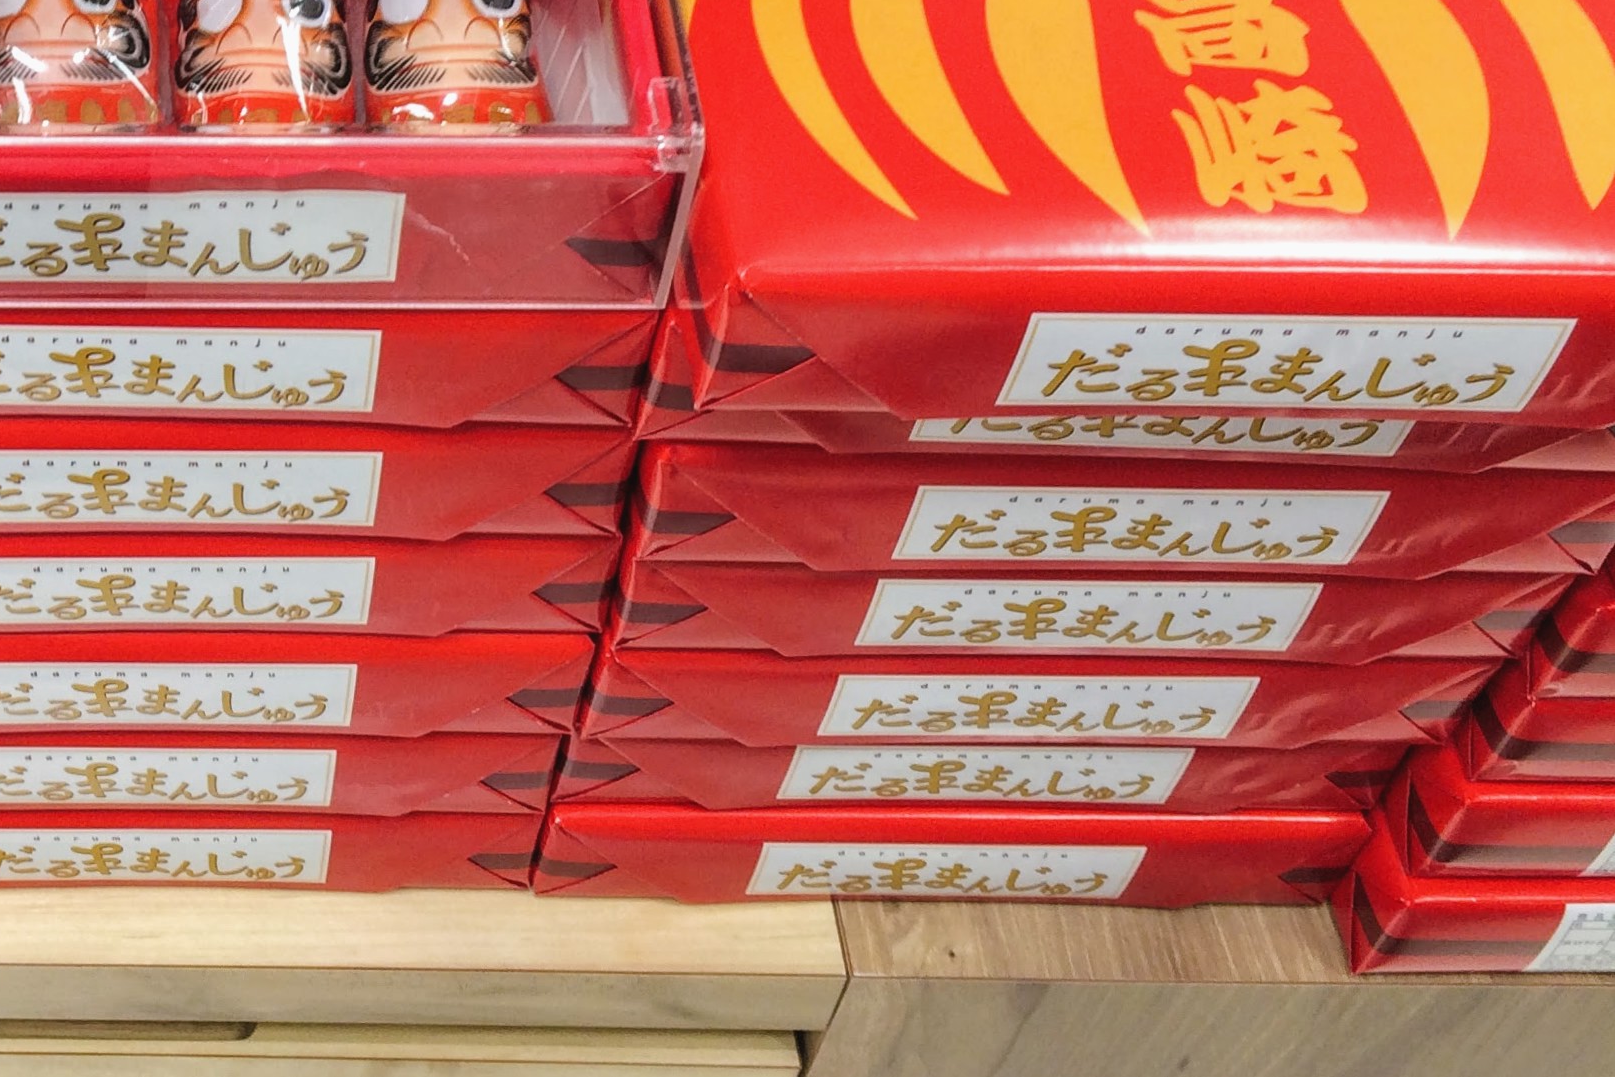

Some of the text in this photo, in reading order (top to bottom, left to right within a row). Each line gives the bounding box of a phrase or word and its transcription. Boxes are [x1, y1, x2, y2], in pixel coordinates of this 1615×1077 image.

[4, 199, 304, 210] daruma manju
[1136, 326, 1465, 340] daruma manju
[1, 336, 287, 348] daruma manju
